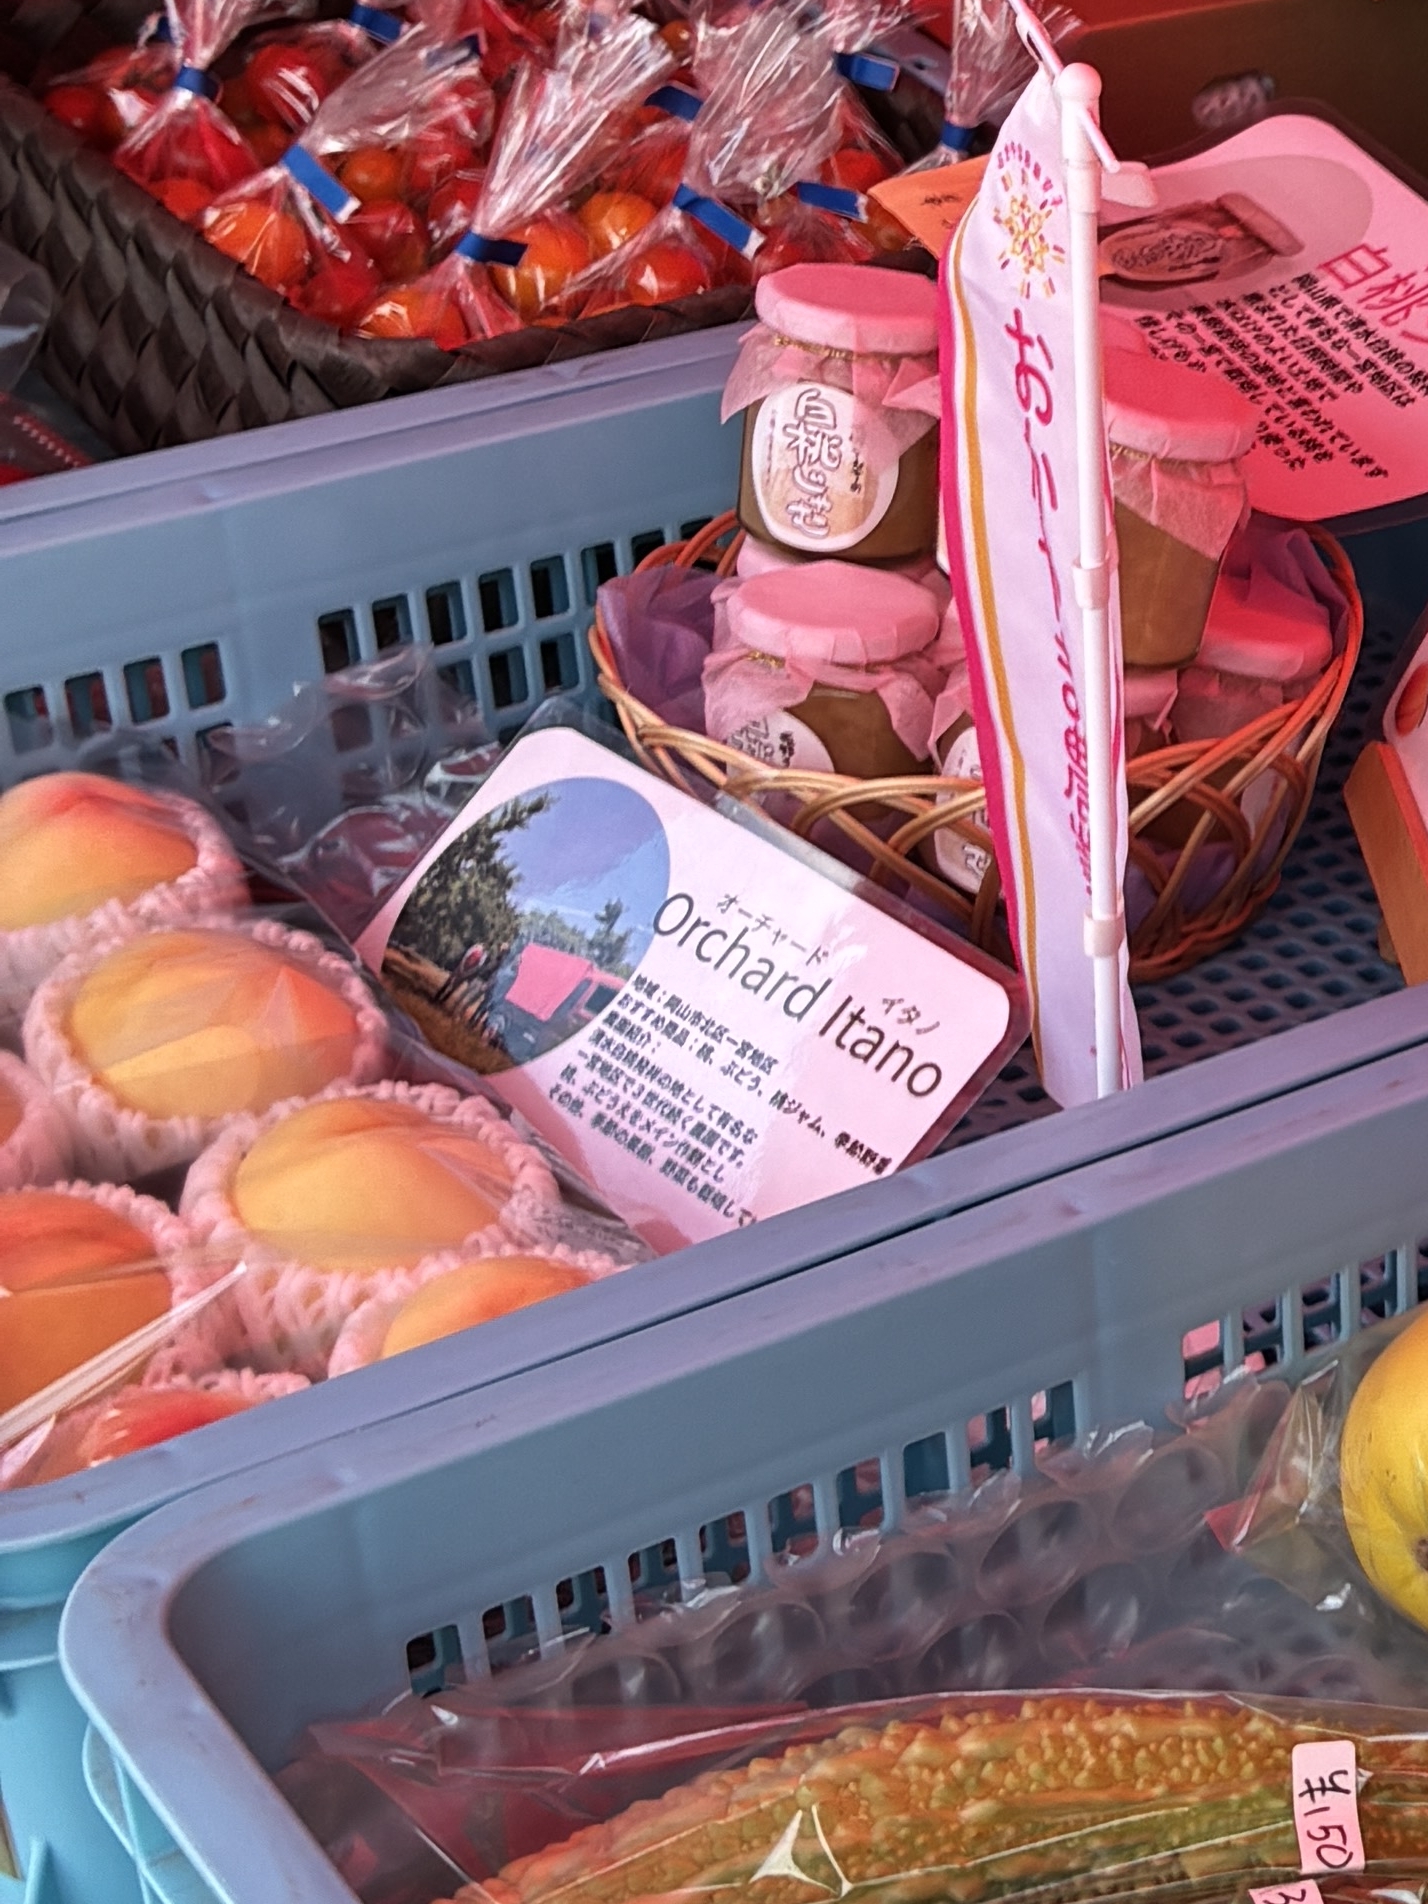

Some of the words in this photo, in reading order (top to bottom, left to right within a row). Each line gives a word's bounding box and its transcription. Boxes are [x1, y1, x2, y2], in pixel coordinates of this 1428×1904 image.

[652, 892, 833, 1024] Orchard
[817, 994, 943, 1098] Itano
[716, 893, 830, 967] オーチャード
[882, 997, 941, 1036] イタノ
[1298, 1768, 1354, 1870] ¥150
